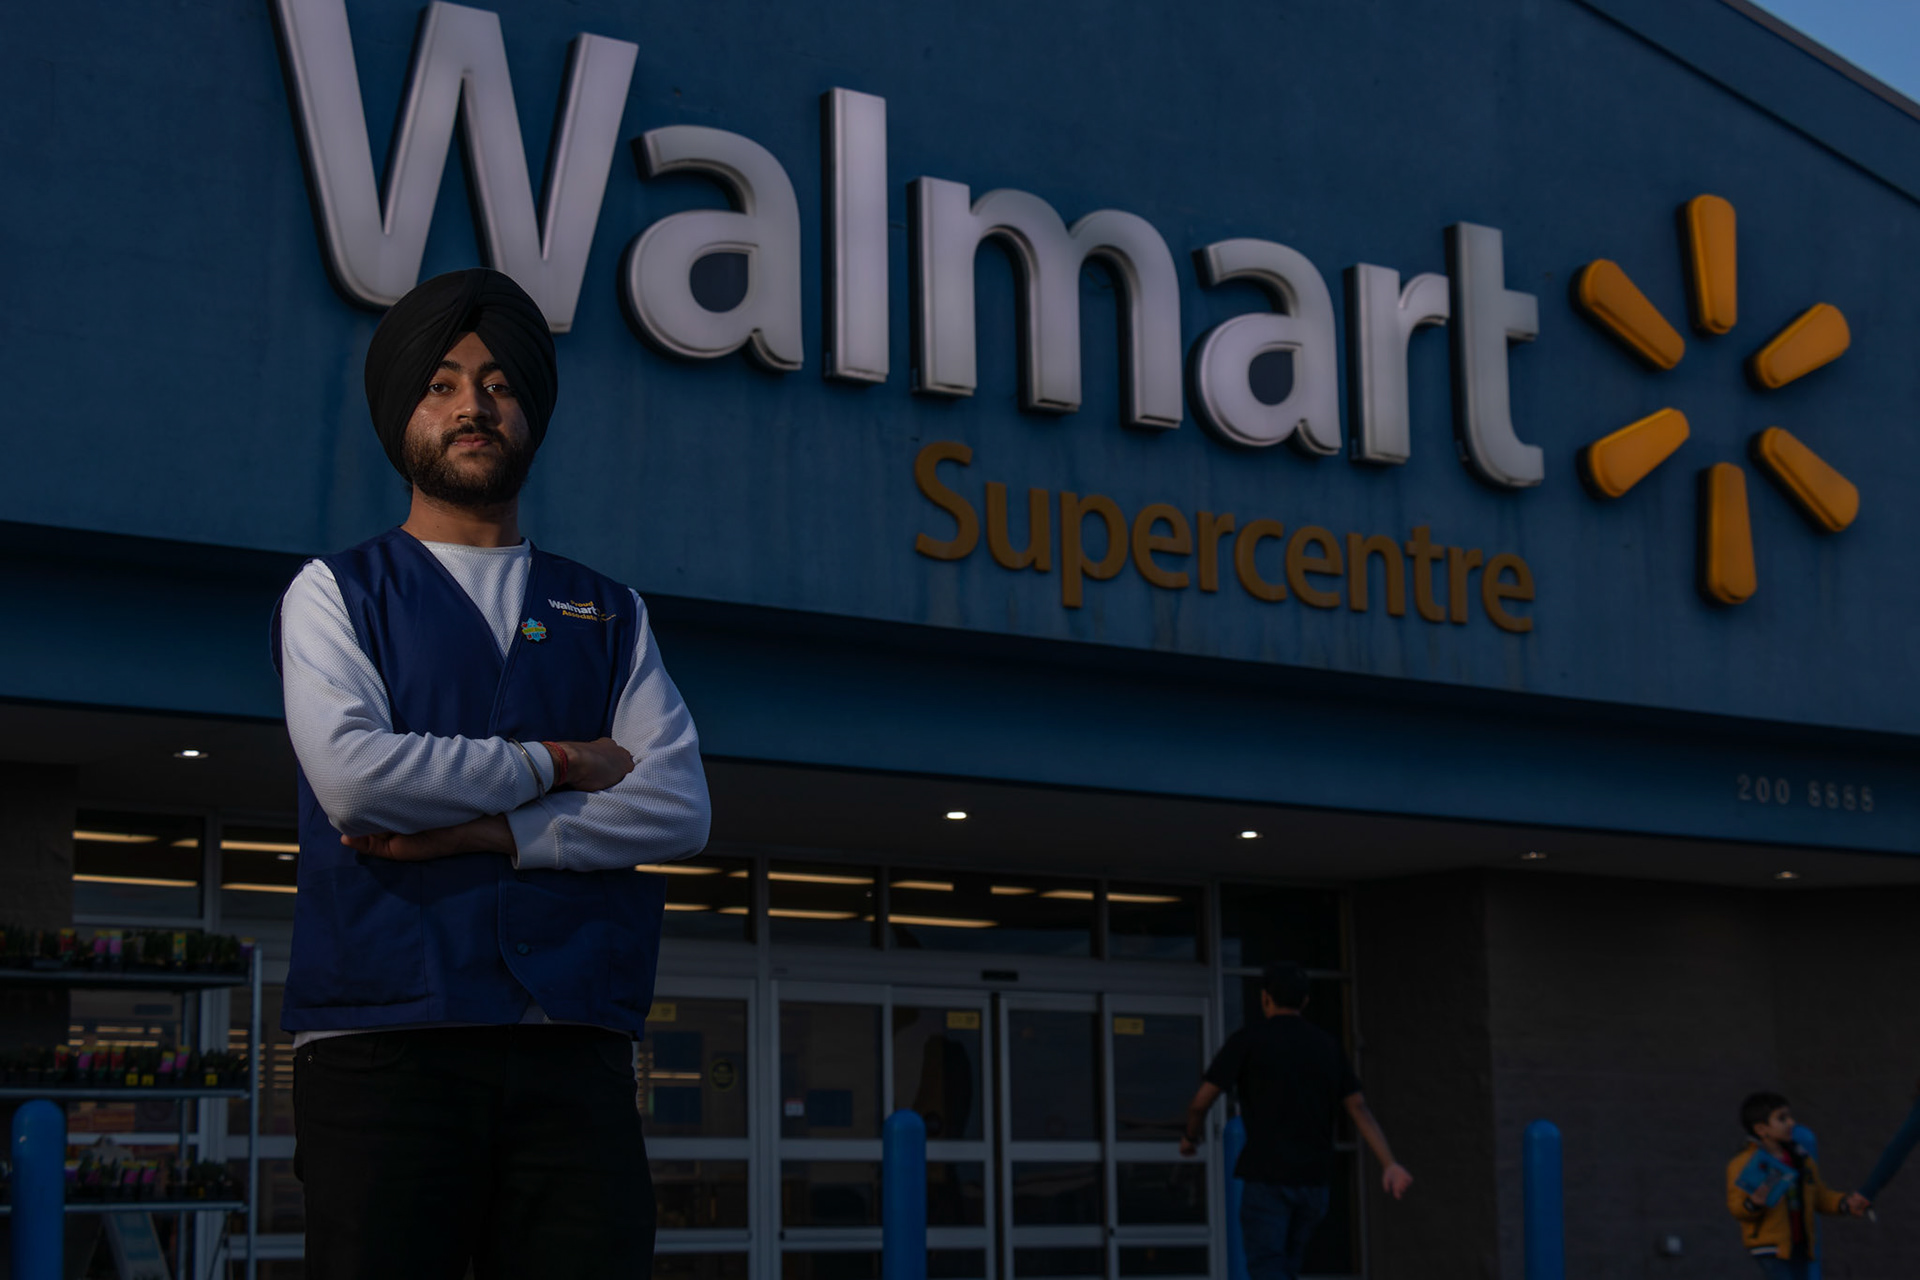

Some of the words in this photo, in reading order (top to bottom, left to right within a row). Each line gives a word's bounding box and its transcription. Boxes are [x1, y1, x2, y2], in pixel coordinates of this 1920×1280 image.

[272, 0, 1546, 488] Walmart
[915, 441, 1535, 634] Supercentre
[548, 599, 598, 615] Walmart
[1737, 774, 1790, 804] 200
